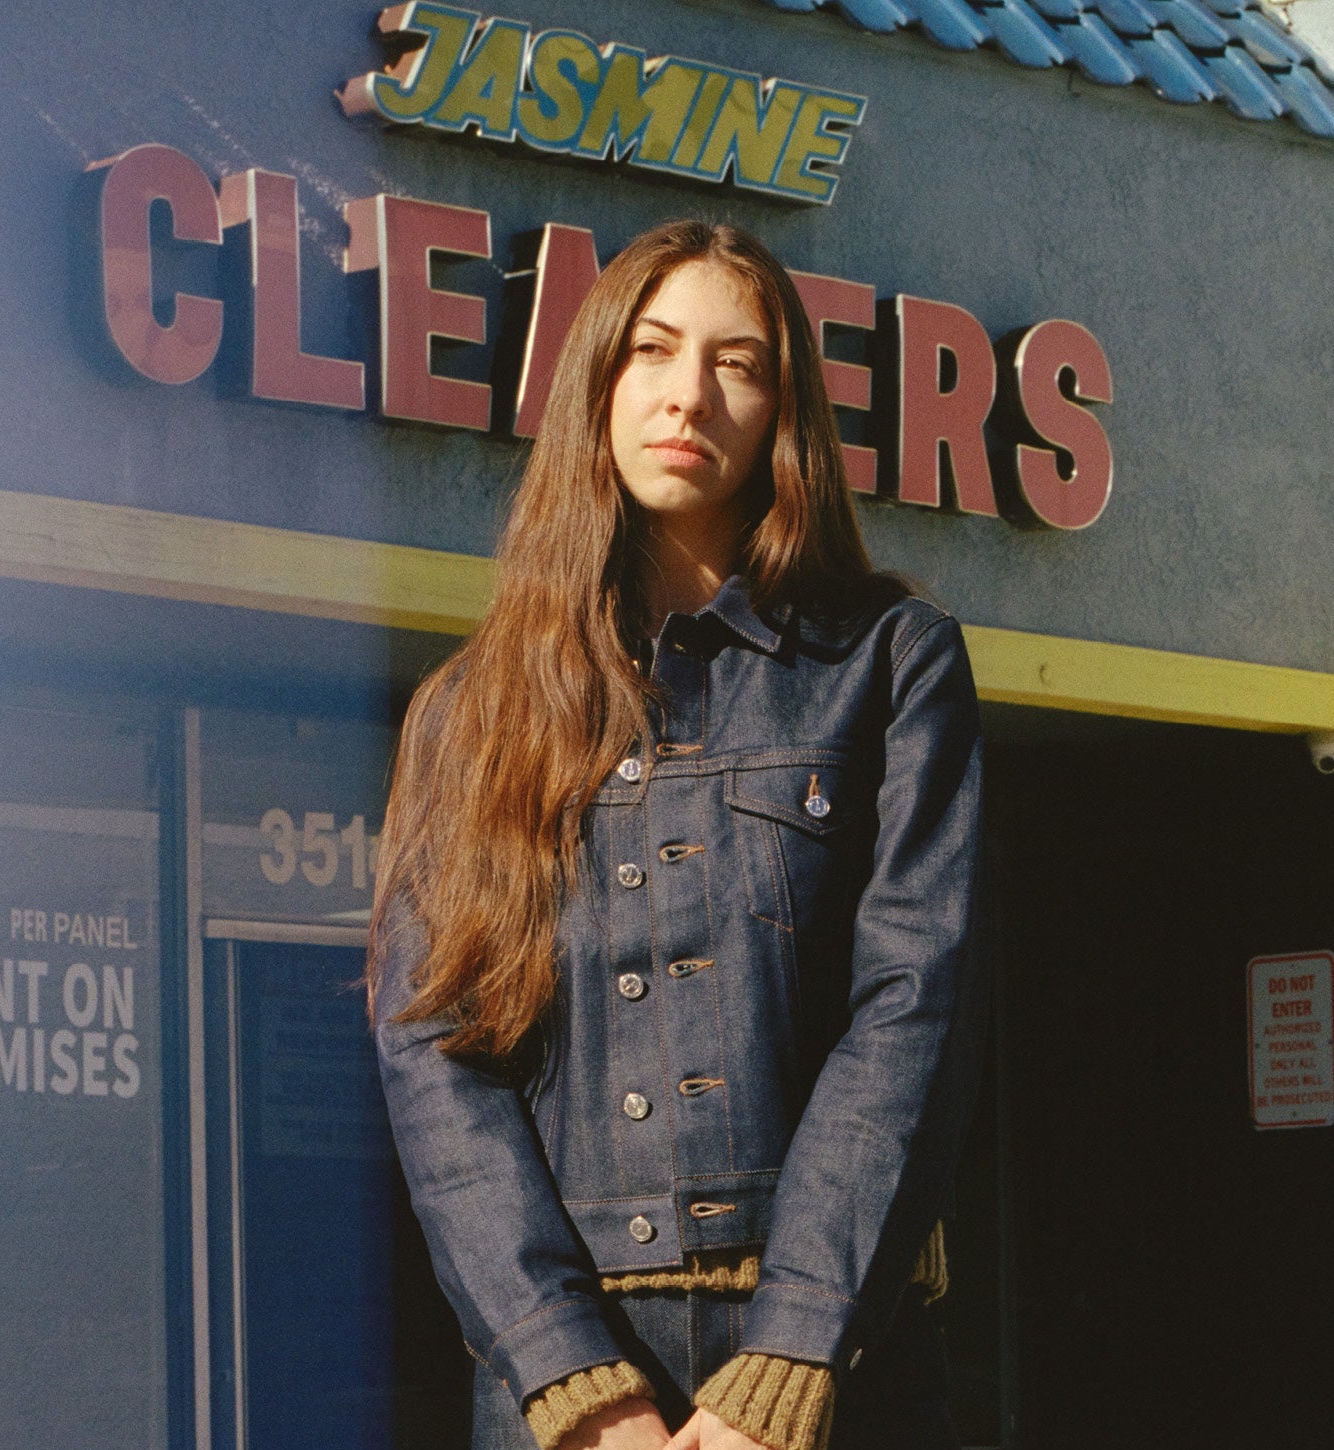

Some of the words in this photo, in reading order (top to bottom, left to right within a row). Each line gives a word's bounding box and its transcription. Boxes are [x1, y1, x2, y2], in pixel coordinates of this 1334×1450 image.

[369, 2, 866, 204] JASMINE
[260, 808, 379, 889] 351
[10, 907, 48, 942] PER
[54, 912, 138, 950] PANEL
[63, 962, 135, 1030] ON
[1267, 977, 1286, 994] DO
[1290, 975, 1315, 992] NOT
[1272, 1000, 1312, 1018] ENTER
